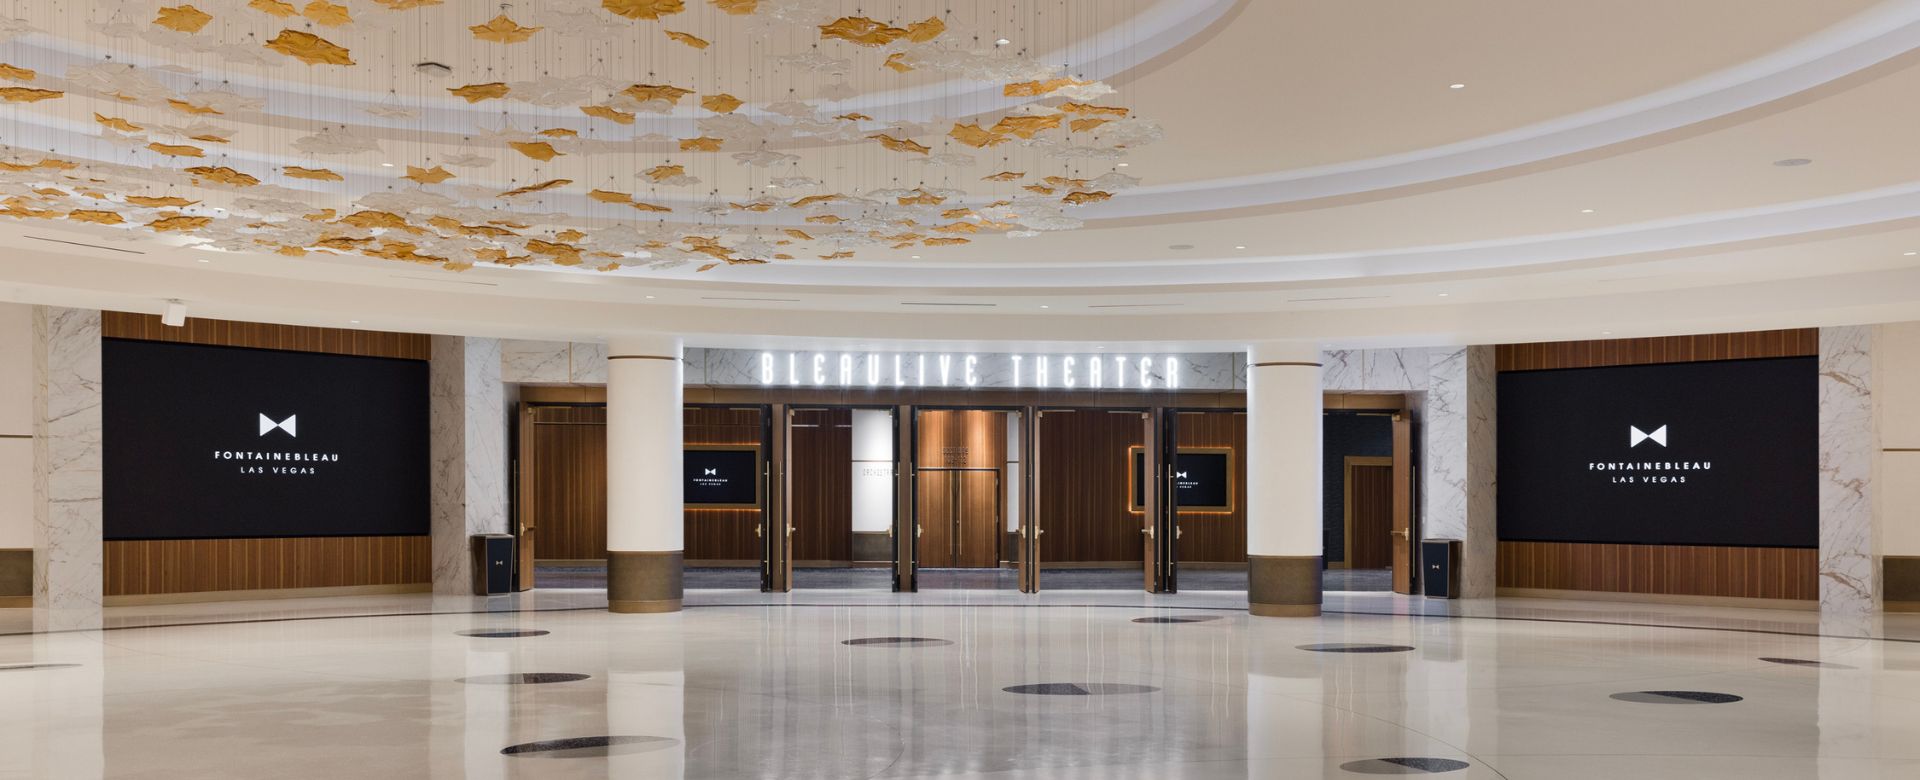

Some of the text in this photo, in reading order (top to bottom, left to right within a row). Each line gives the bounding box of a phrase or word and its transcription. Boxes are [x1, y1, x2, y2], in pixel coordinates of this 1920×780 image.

[761, 352, 1179, 389] BLEAULIVE THEATER
[214, 450, 339, 462] FONTAINEBLEAU
[240, 466, 315, 475] LAS VEGAS
[1589, 461, 1711, 471] FONTAINEBLEAU
[1612, 475, 1686, 484] LAS VEGAS
